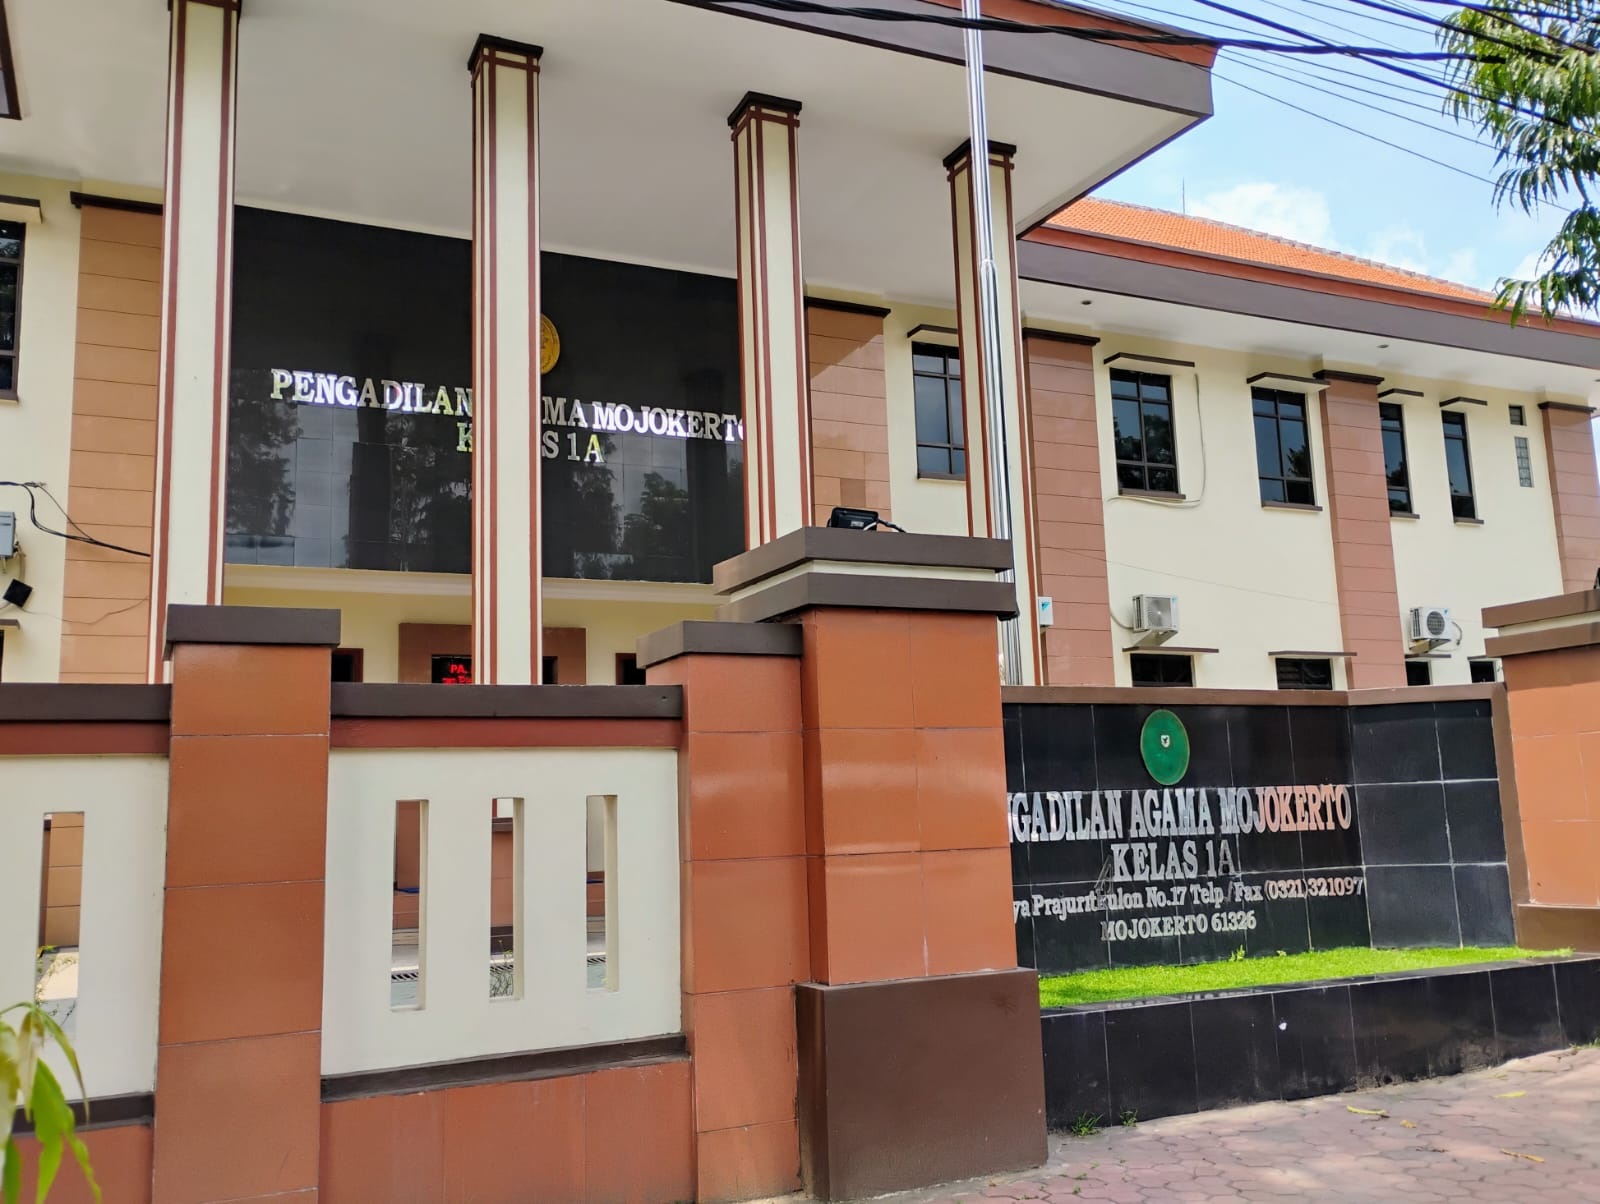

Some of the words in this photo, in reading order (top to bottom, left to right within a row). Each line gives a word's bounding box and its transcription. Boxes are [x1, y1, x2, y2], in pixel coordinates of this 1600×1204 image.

[270, 368, 473, 417] PENGADILAN
[568, 432, 604, 463] 1A
[1007, 790, 1123, 843] GADILAN
[1130, 787, 1215, 838] AGAMA
[1218, 784, 1351, 834] MOJOKERTO
[1110, 840, 1198, 882] KELAS
[1206, 839, 1236, 877] 1A
[1101, 912, 1208, 941] MOJOKERTO
[1211, 910, 1257, 932] 61326
